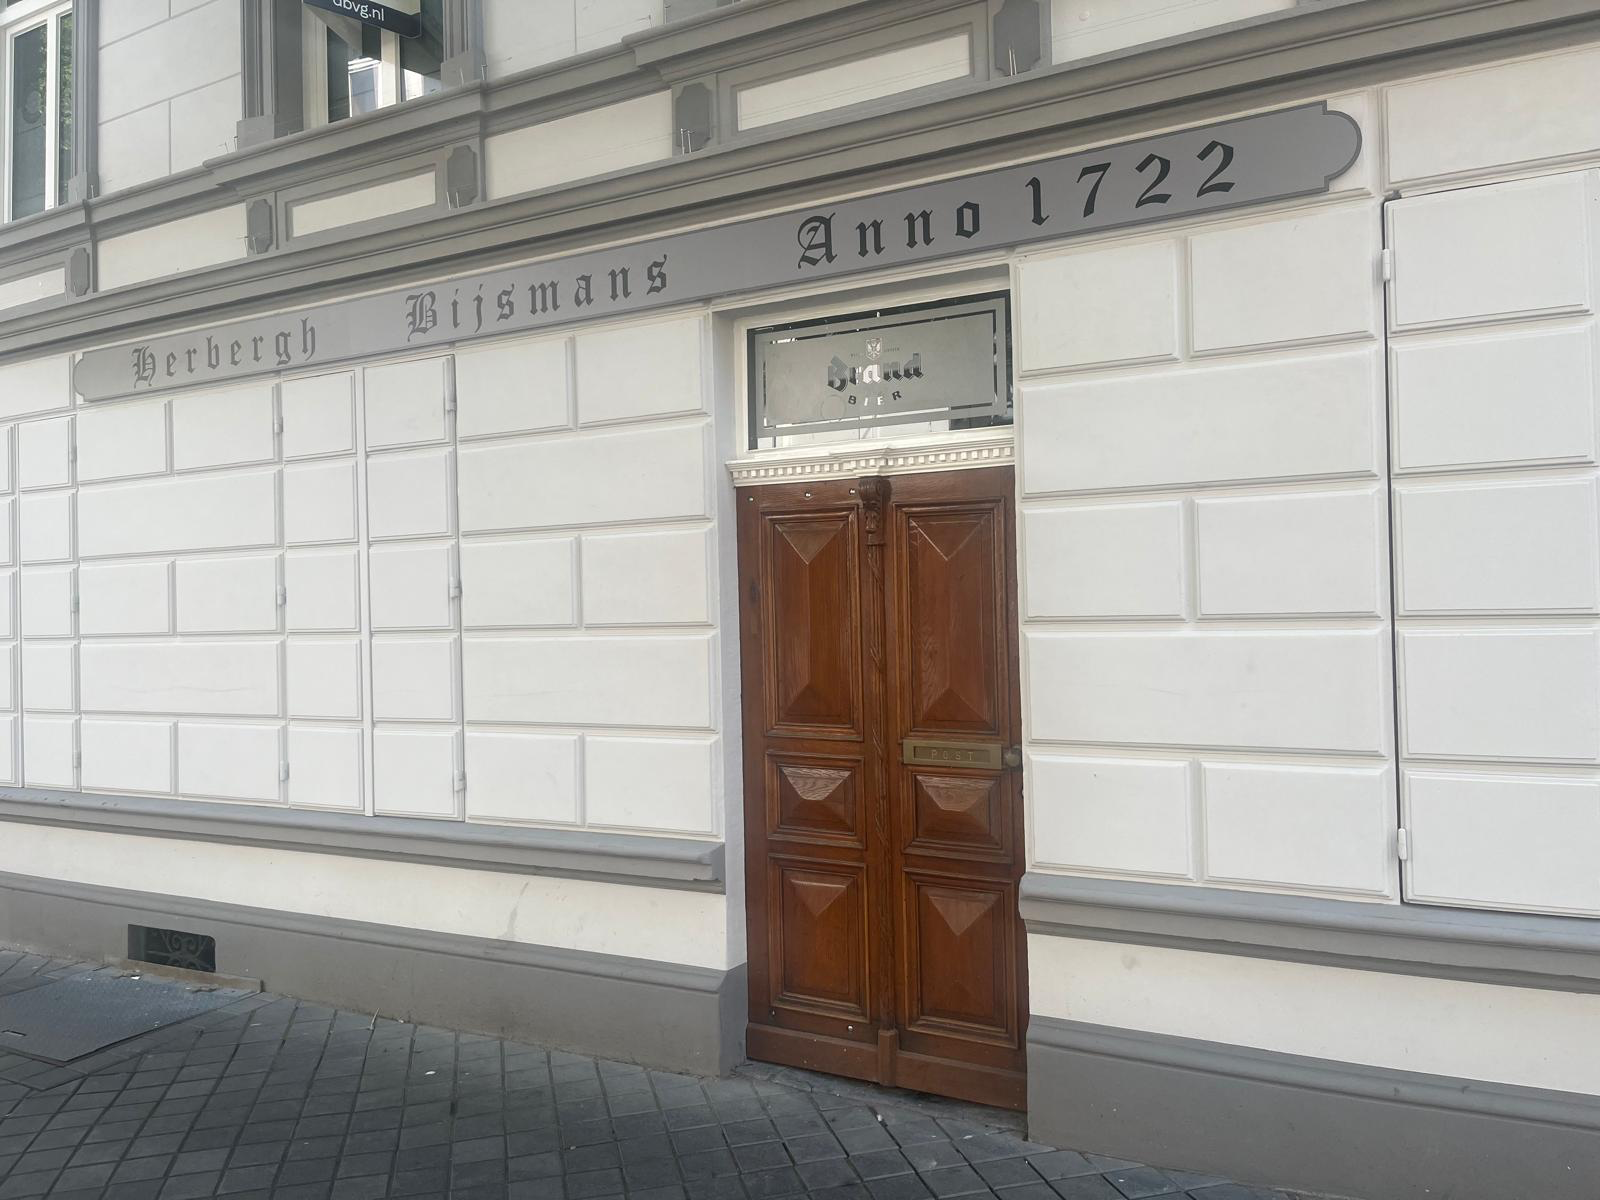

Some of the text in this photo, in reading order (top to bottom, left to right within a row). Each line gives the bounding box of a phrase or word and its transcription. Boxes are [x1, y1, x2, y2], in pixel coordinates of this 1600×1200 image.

[132, 139, 1236, 389] Herbergh Bijsmans Anno 1722
[827, 353, 924, 393] Brand
[848, 390, 902, 407] BIER
[931, 749, 974, 761] POST
